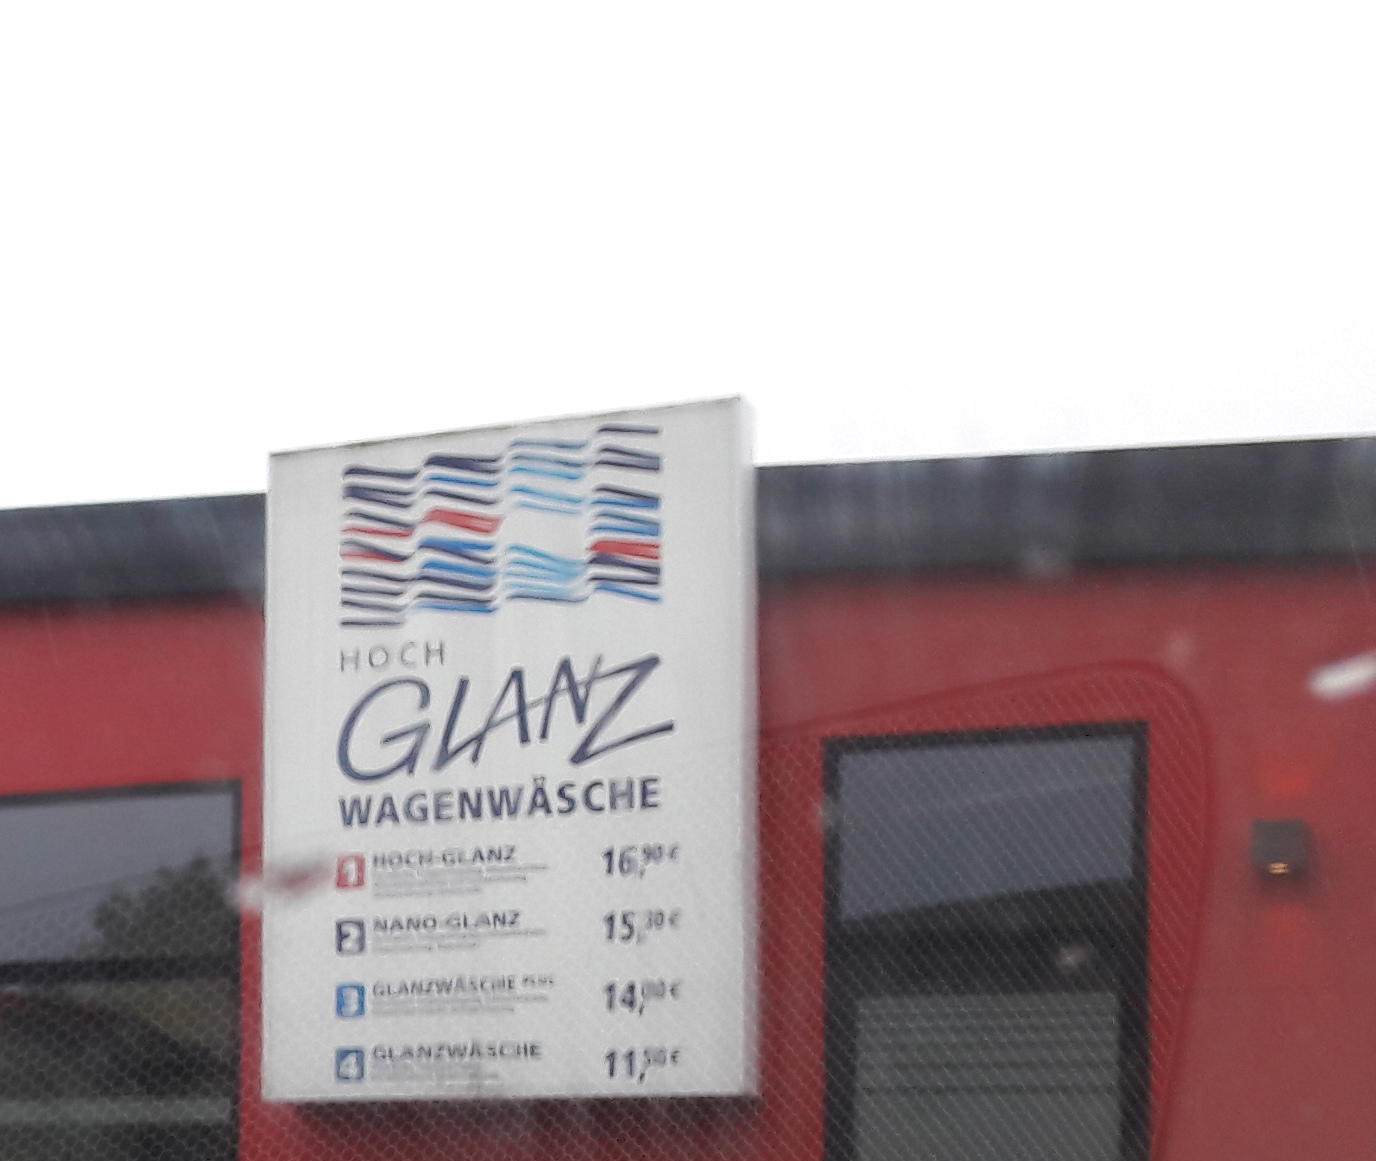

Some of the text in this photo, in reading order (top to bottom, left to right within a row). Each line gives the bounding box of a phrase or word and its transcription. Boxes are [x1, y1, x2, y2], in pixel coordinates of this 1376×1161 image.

[340, 640, 445, 672] HOCH
[338, 653, 675, 782] GLANZ
[339, 776, 661, 827] WAGENWÄSCHE
